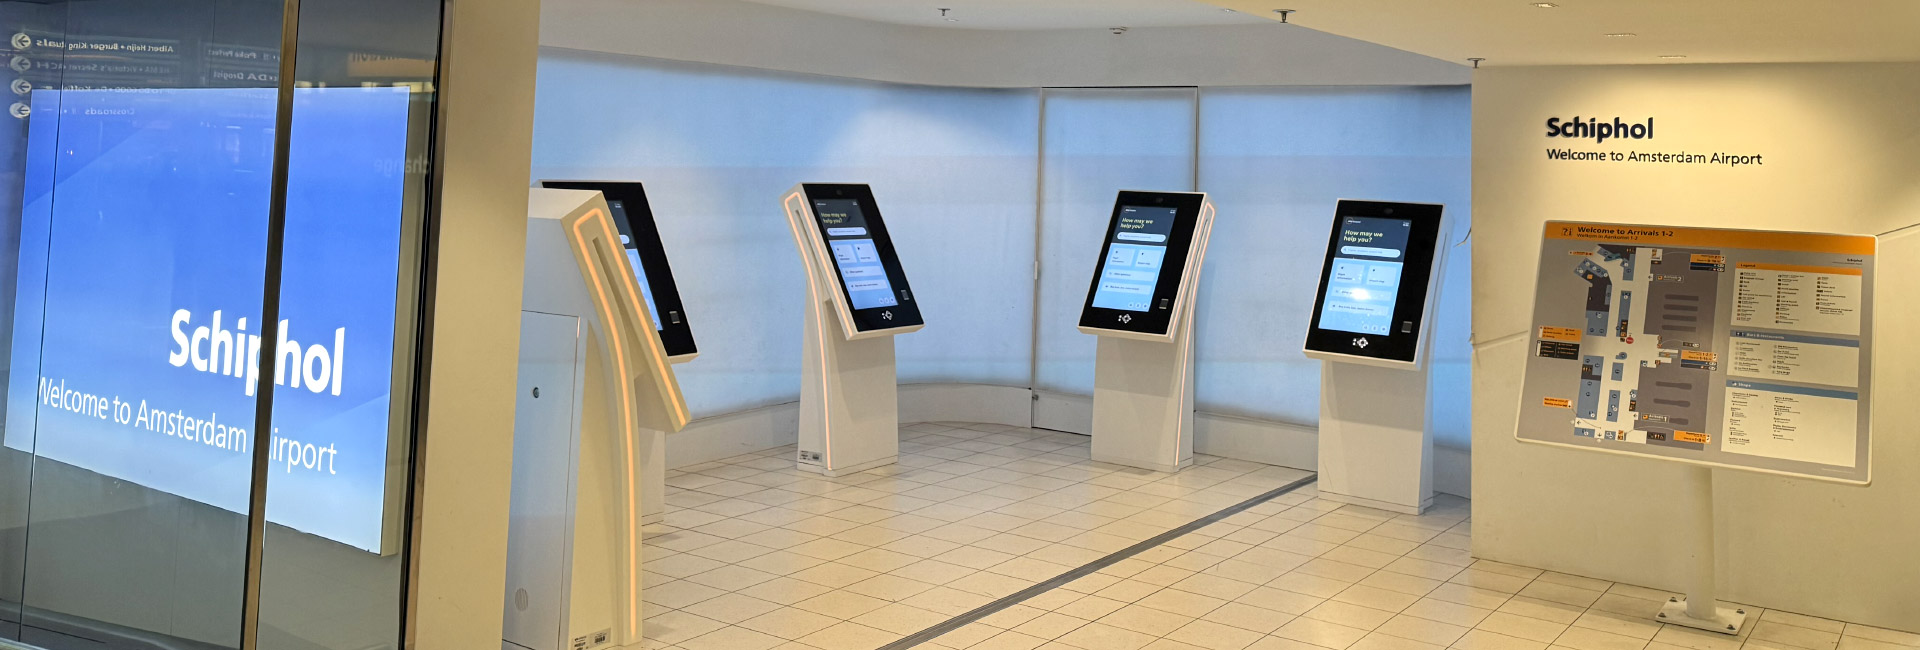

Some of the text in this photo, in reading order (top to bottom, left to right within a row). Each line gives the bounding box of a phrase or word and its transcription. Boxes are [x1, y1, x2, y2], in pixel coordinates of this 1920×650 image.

[1546, 116, 1654, 144] Schiphol
[1547, 148, 1763, 168] Welcome to Amsterdam Airport
[1578, 226, 1615, 235] Welcome
[1627, 229, 1660, 237] Arrivals
[1662, 230, 1674, 238] 1-2
[169, 308, 346, 397] Schiphol
[39, 376, 338, 475] Welcome to Amsterdam irport
